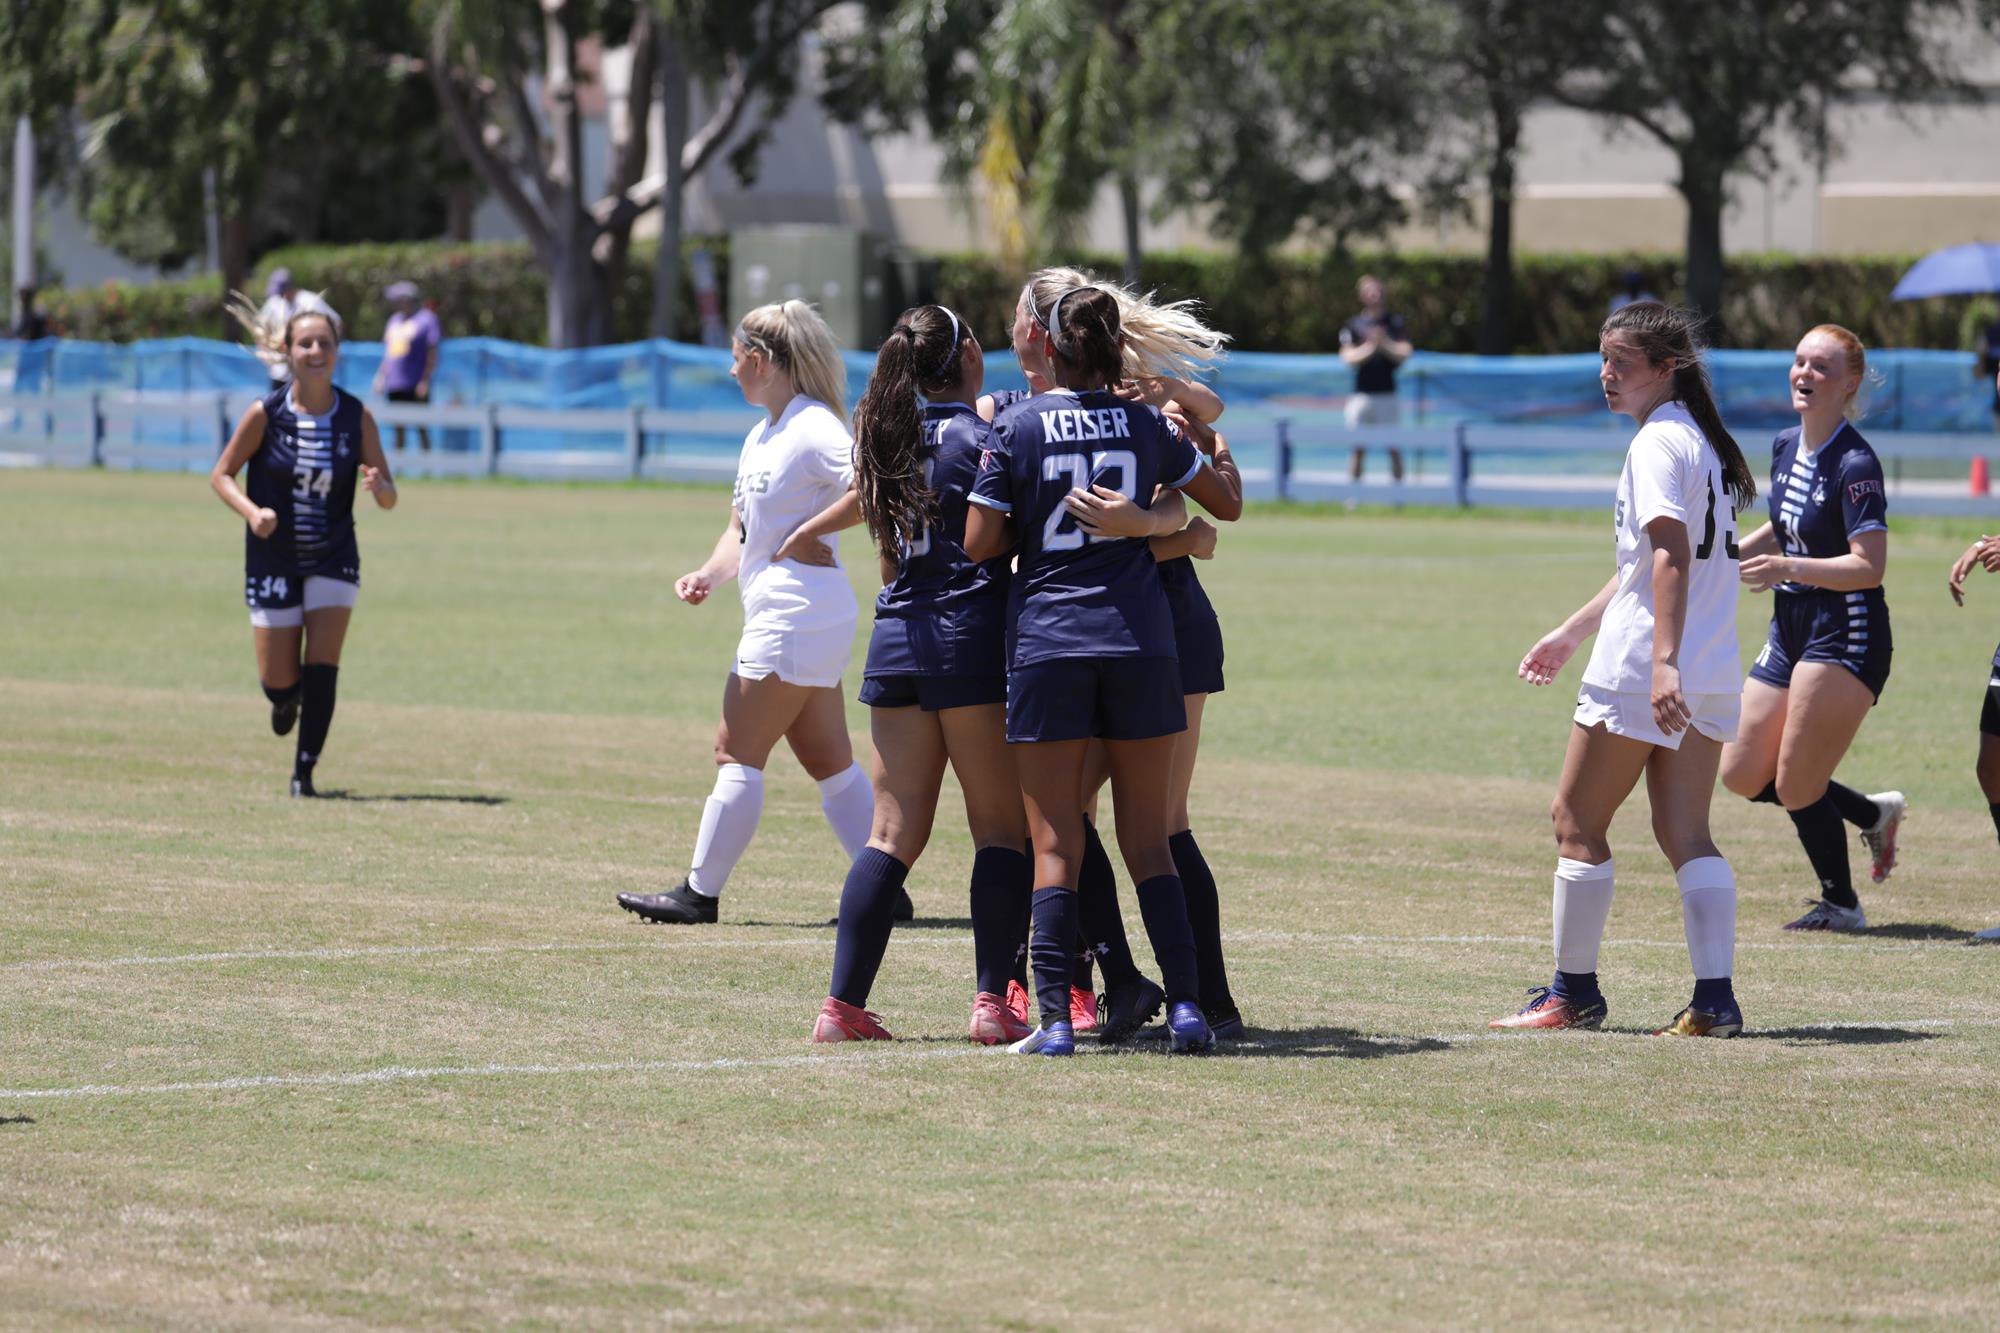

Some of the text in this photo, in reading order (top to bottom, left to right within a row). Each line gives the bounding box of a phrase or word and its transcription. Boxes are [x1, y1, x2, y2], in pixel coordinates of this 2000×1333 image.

[1039, 407, 1131, 444] KEISER
[292, 465, 333, 500] 34
[1779, 510, 1809, 555] 31
